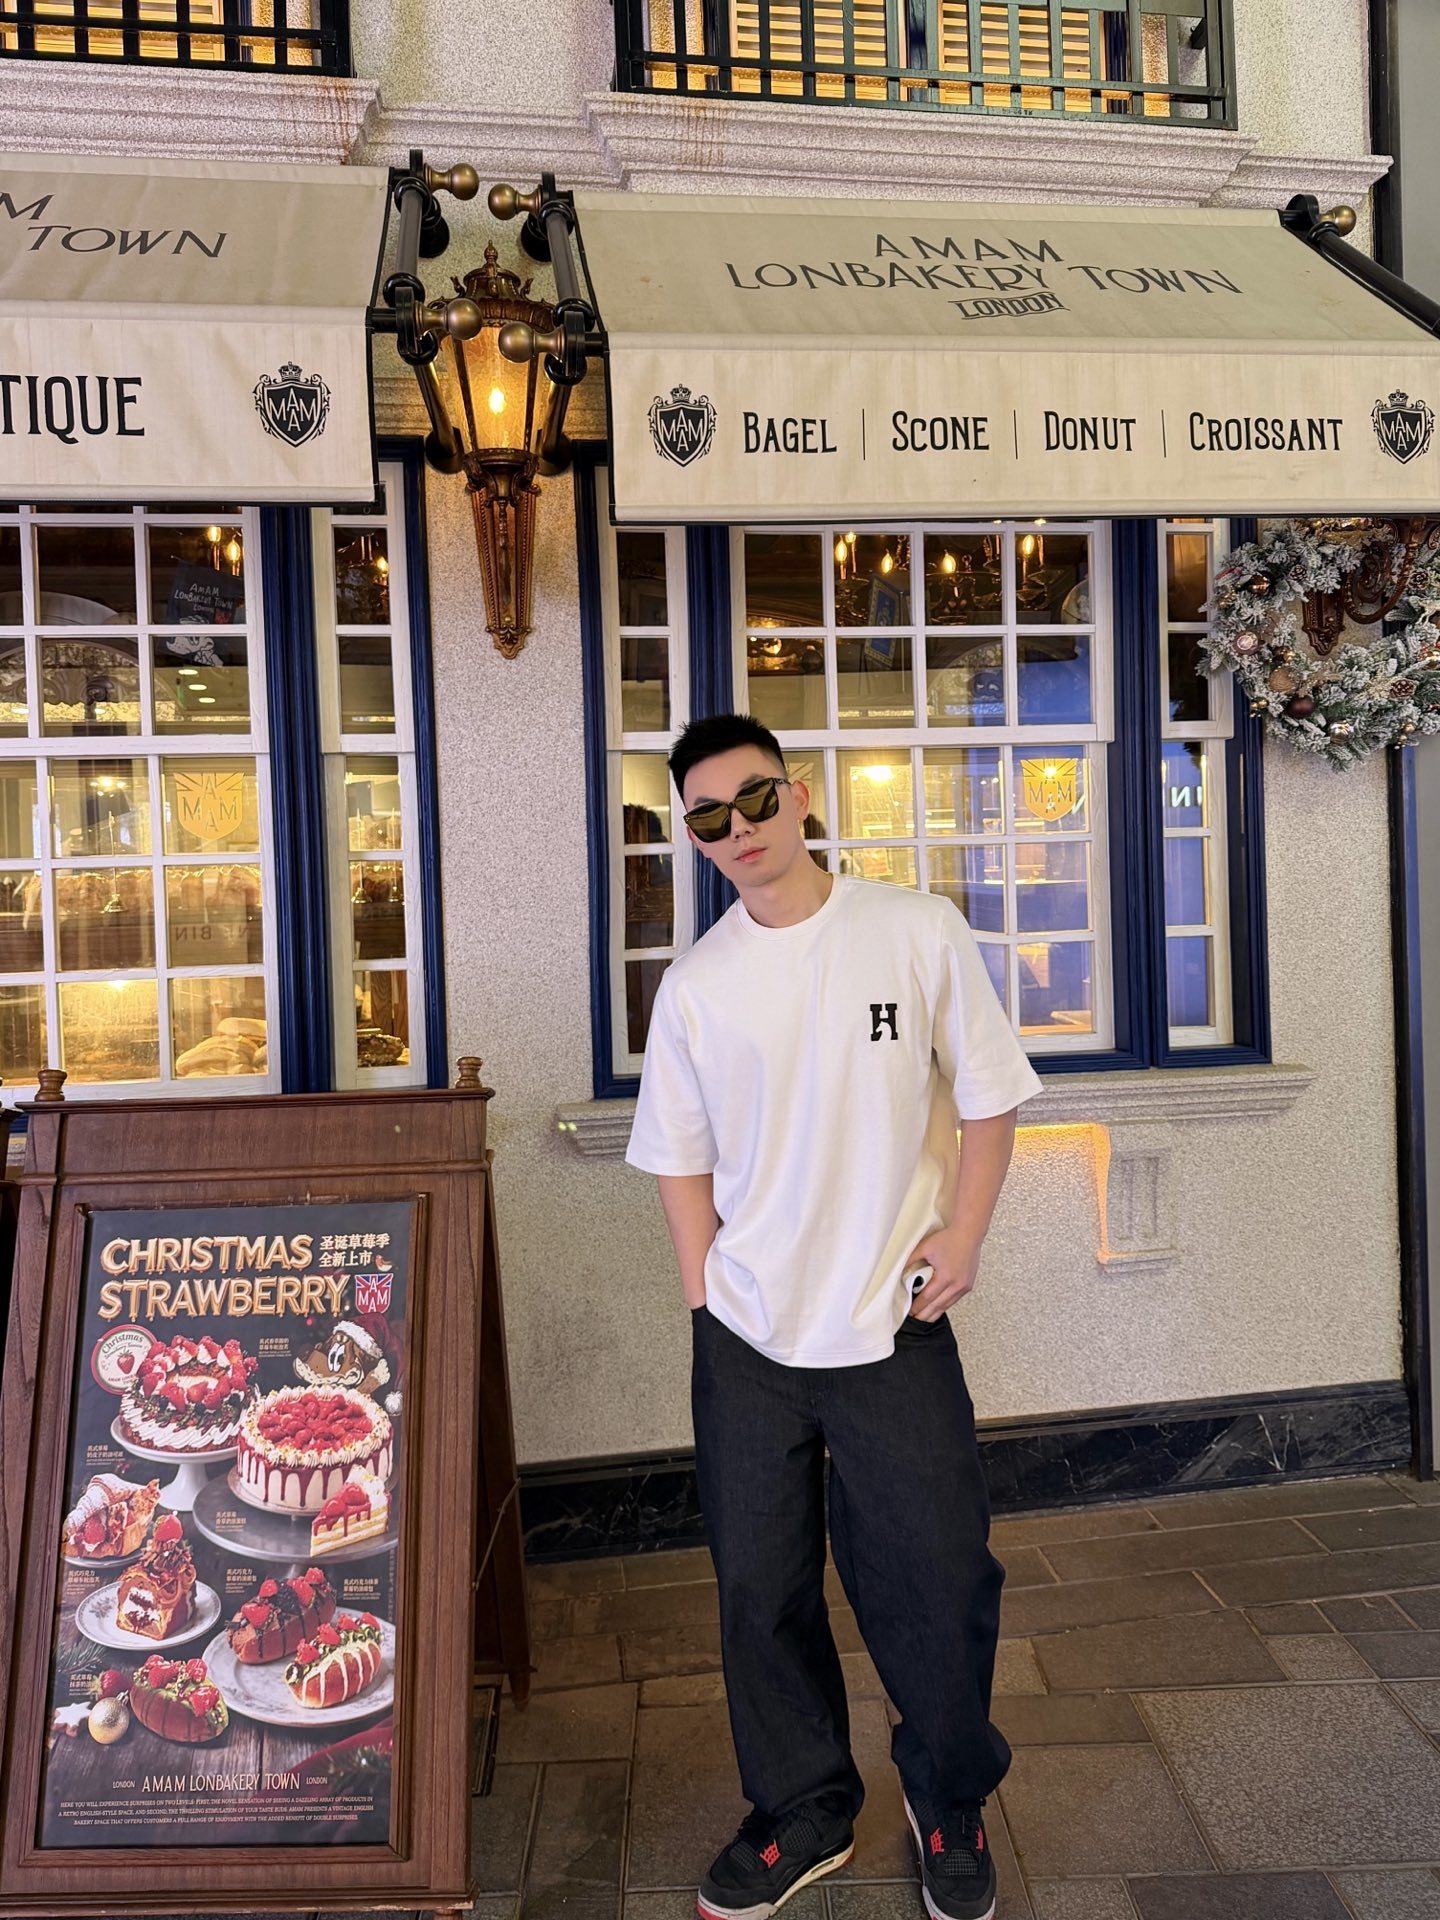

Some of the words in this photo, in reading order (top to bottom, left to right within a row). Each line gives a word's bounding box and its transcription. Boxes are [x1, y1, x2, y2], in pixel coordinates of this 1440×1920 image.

[27, 225, 228, 258] TOWN
[875, 234, 1064, 263] AMAM
[723, 262, 1050, 291] LONBAKERY
[1067, 265, 1243, 294] TOWN
[955, 292, 1064, 317] LONDON
[0, 375, 145, 445] TIQUE
[100, 1234, 313, 1275] CHRISTMAS
[320, 1233, 390, 1250] 圣诞草莓季
[318, 1250, 373, 1267] 全新上市
[98, 1275, 351, 1321] STRAWBERRY
[102, 1333, 144, 1354] Christmas
[112, 1780, 135, 1789] LONDON
[142, 1775, 186, 1792] AMAM
[189, 1773, 260, 1791] LONBAKERY
[265, 1772, 300, 1790] TOWN
[306, 1776, 328, 1785] LONDON
